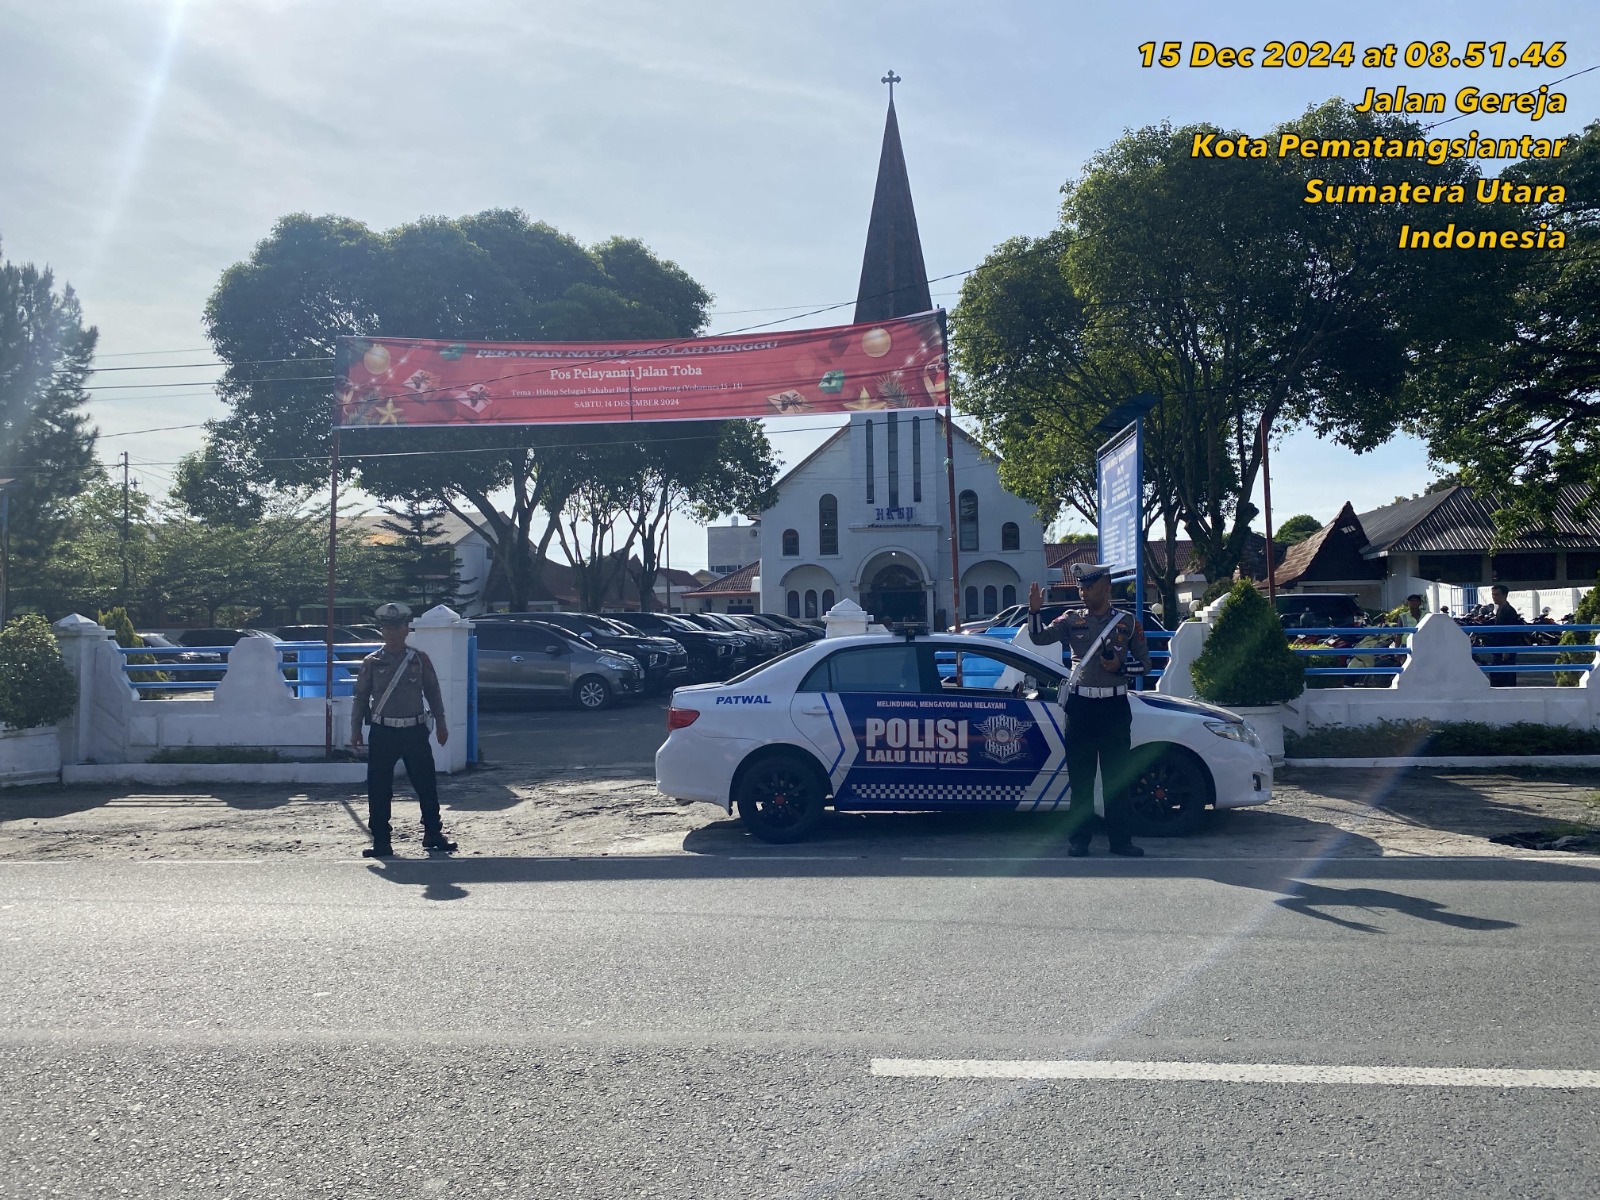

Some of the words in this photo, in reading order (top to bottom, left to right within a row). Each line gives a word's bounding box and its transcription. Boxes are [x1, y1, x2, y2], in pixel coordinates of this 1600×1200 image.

[475, 349, 562, 358] PERAYAAN
[565, 349, 623, 358] NATAL
[707, 341, 778, 353] MINGGU
[550, 369, 571, 380] Pos
[573, 368, 635, 381] Pelayanan
[636, 366, 668, 380] Jalan
[670, 365, 702, 376] Toba
[536, 389, 558, 397] Hidup
[559, 388, 586, 397] Sebagai
[659, 385, 681, 393] Orang
[660, 398, 679, 406] 2024
[716, 695, 771, 704] PATWAL
[876, 700, 919, 709] MELINDUNGI,
[866, 717, 968, 749] POLISI
[866, 750, 906, 762] LALU
[910, 751, 968, 764] LINTAS
